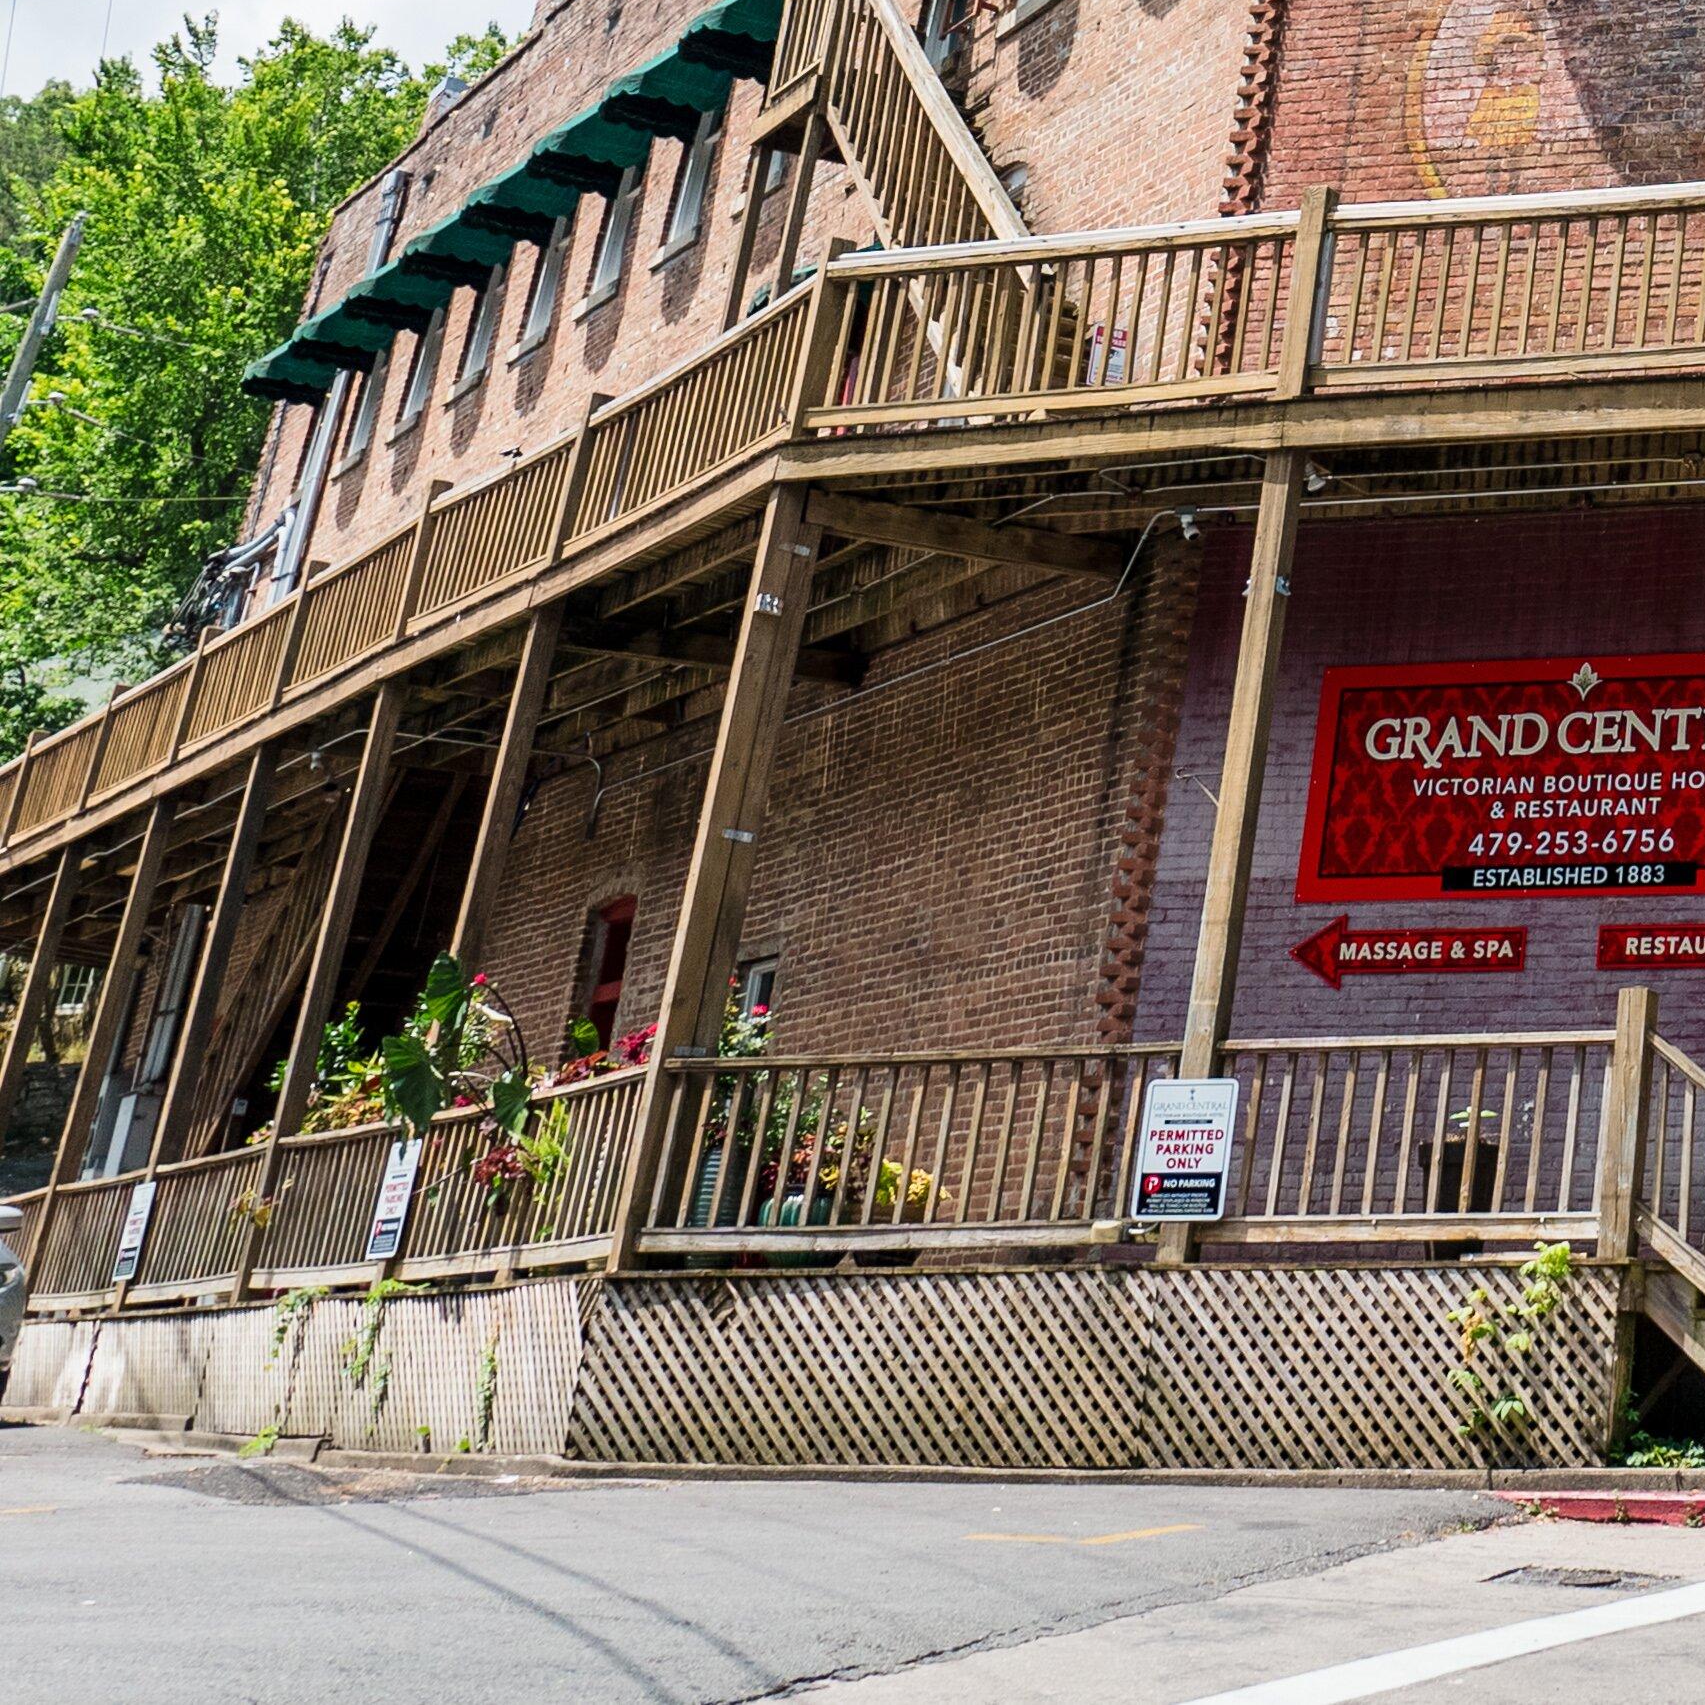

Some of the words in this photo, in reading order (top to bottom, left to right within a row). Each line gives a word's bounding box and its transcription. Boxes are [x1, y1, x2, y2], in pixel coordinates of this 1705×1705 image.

[1365, 712, 1549, 769] GRAND
[1413, 777, 1534, 797] VICTORIAN
[1543, 772, 1663, 794] BOUTIQUE
[1490, 802, 1506, 819] &
[1513, 797, 1662, 819] RESTAURANT
[1468, 828, 1676, 857] 479-253-6756
[1472, 867, 1609, 888] ESTABLISHED
[1615, 864, 1666, 885] 1883
[1339, 941, 1447, 961] MASSAGE
[1450, 941, 1470, 960] &
[1473, 940, 1514, 959] SPA
[1150, 1129, 1224, 1141] PERMITTED
[1156, 1144, 1214, 1155] PARKING
[1166, 1158, 1202, 1169] ONLY
[1163, 1179, 1178, 1188] NO
[1178, 1178, 1216, 1188] PARKING
